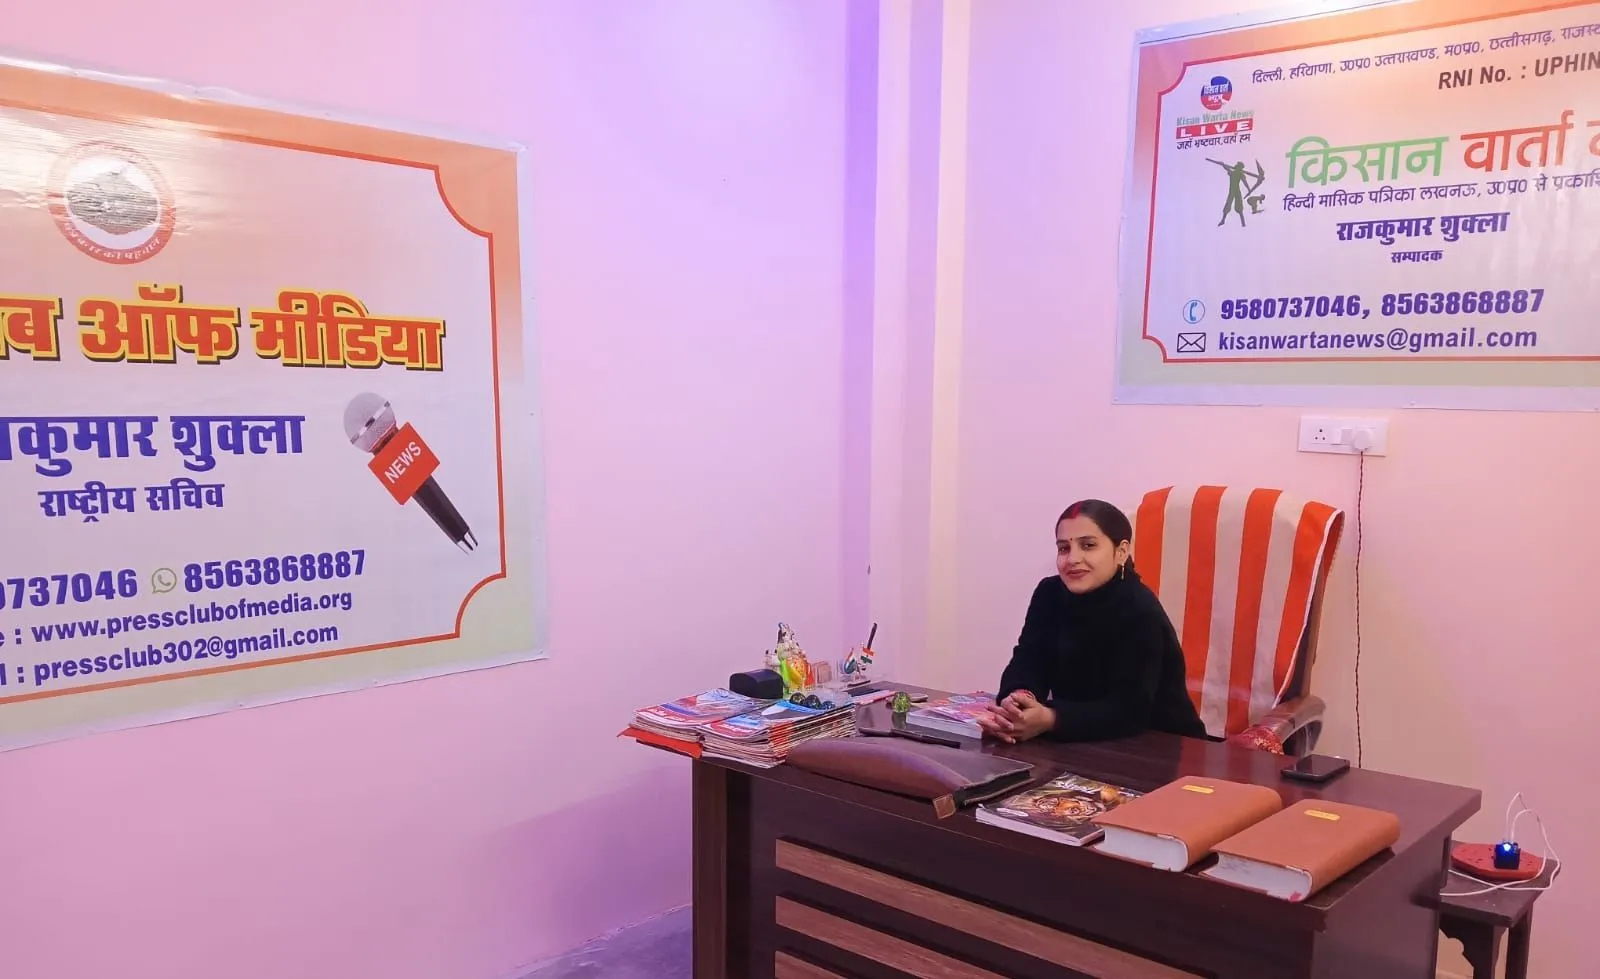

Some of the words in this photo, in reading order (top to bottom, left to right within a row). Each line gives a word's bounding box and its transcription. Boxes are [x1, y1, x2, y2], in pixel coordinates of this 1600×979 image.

[1438, 69, 1473, 90] RNI
[1479, 65, 1511, 84] No.
[1180, 120, 1250, 138] LIVE
[1230, 109, 1255, 120] News
[1285, 136, 1449, 188] किसान
[1460, 109, 1574, 172] वार्ता
[1283, 192, 1315, 211] हिन्दी
[1319, 189, 1364, 208] मासिक
[1368, 185, 1416, 204] पत्रिका
[1533, 173, 1548, 191] से
[1336, 217, 1436, 245] राजकुमार
[1441, 212, 1510, 242] शुक्ला
[1391, 250, 1443, 263] सम्पादक
[1221, 295, 1370, 319] 9580737046,
[1382, 289, 1545, 316] 8563868887
[78, 283, 241, 364] ऑफ
[249, 290, 446, 371] मीडिया
[1219, 327, 1537, 353] kisanwartanews@gmail.com
[170, 415, 305, 472] शुक्ला
[384, 441, 422, 484] NEWS
[38, 481, 136, 523] राष्ट्रीय
[144, 477, 225, 511] सचिव
[184, 549, 365, 593] 8563868887
[31, 590, 352, 643] www.pressclubofmedia.org
[34, 624, 338, 686] pressclub302@gmail.com
